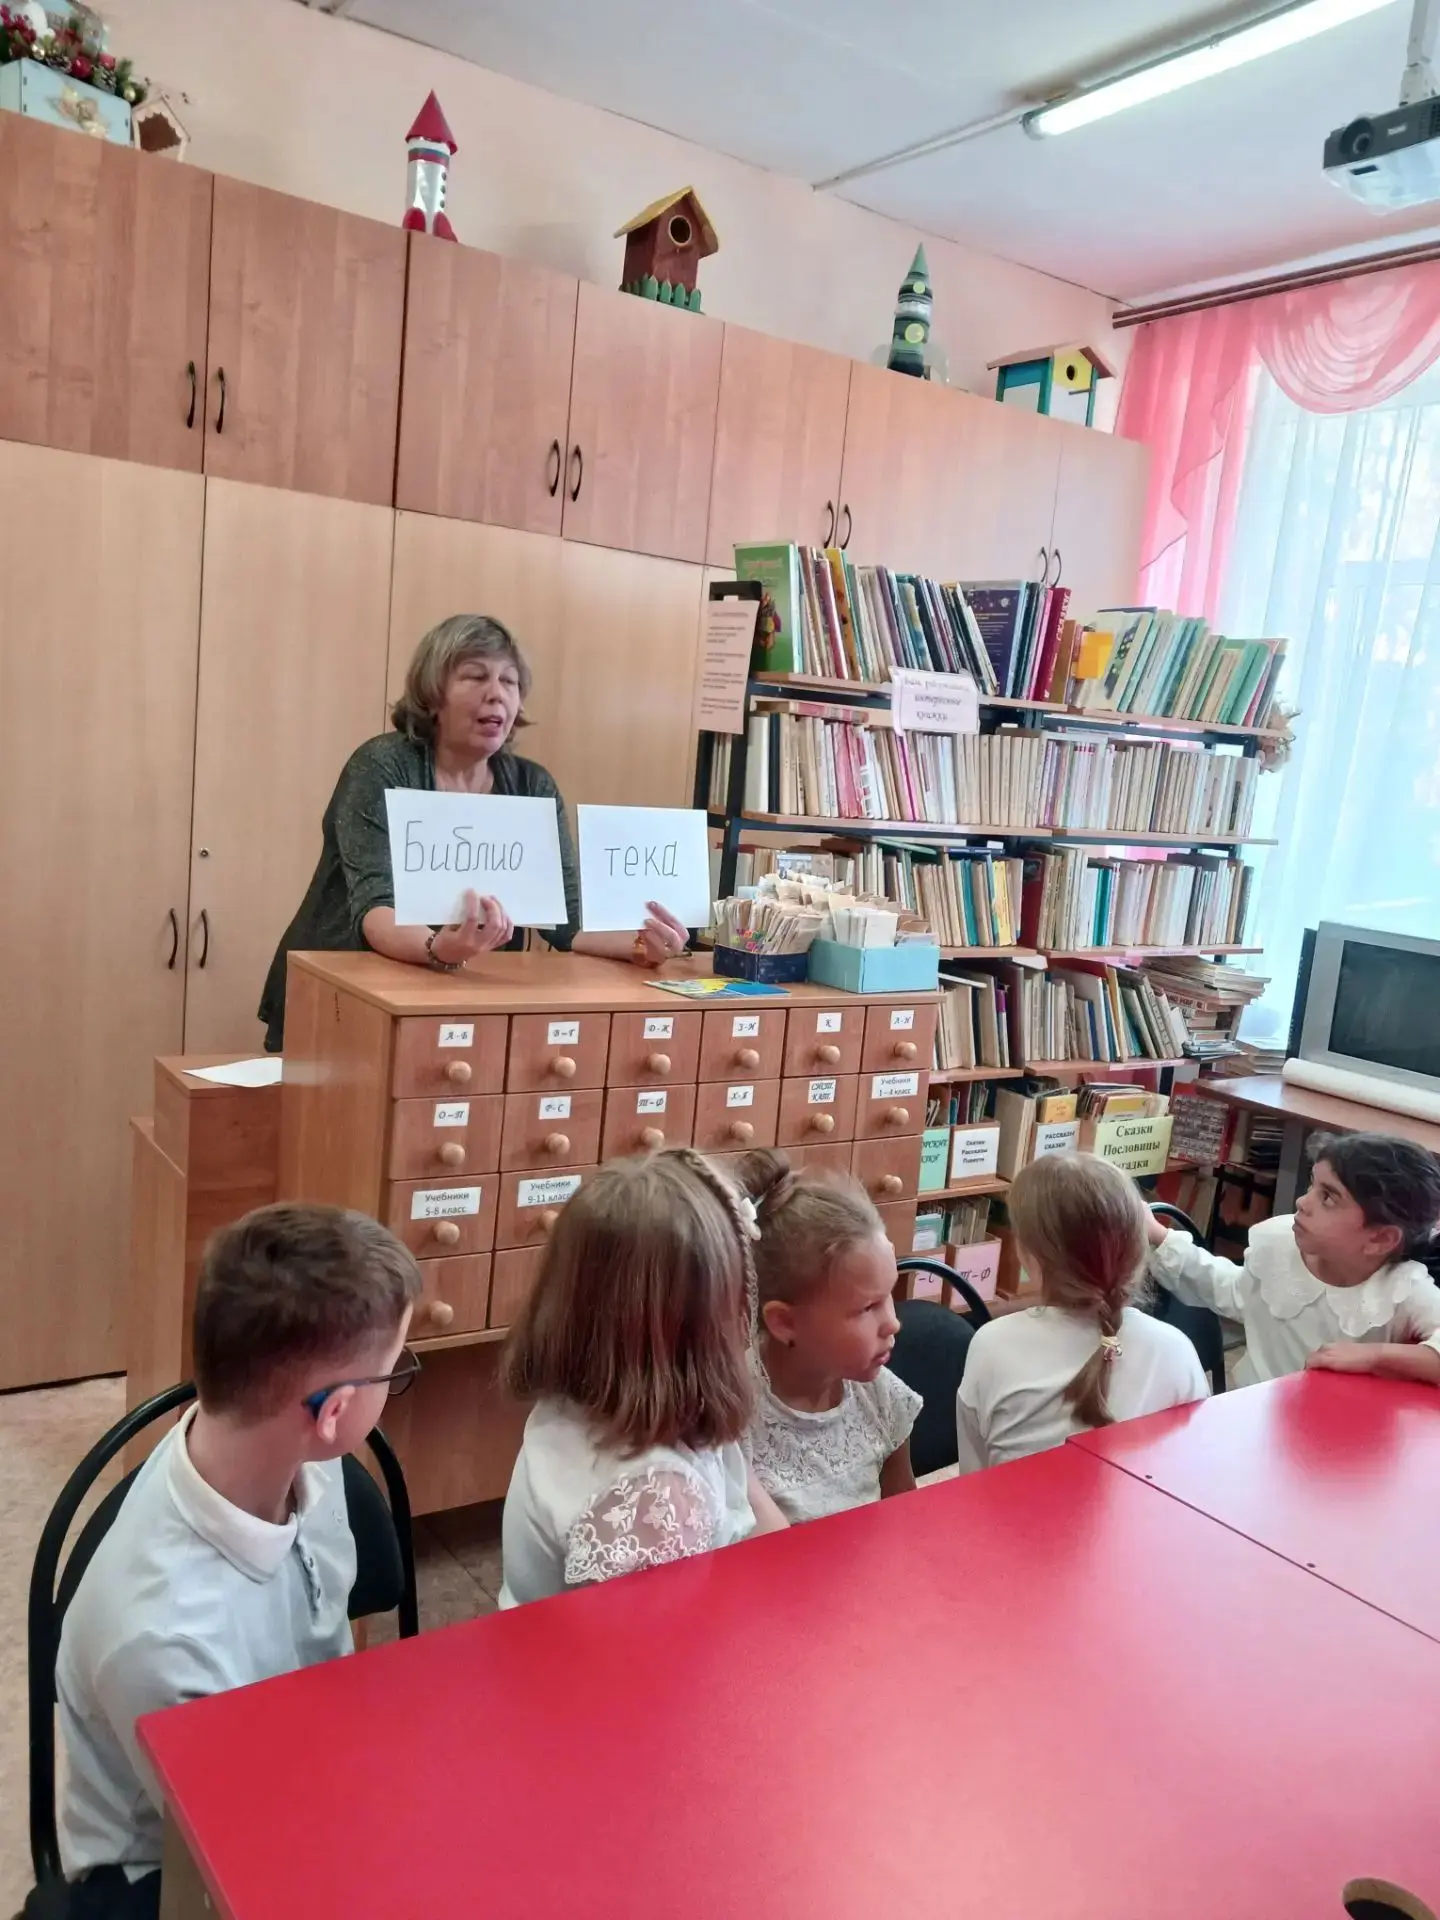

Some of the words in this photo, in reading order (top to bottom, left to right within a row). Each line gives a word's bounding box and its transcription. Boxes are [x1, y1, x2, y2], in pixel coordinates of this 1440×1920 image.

[403, 819, 525, 873] Библио
[604, 840, 679, 877] тека
[880, 1076, 911, 1086] Учебники
[894, 1088, 912, 1096] класс
[1045, 1130, 1075, 1140] РАССКАЗЫ
[1116, 1124, 1153, 1138] Сказки
[1103, 1141, 1161, 1156] Пословицы
[530, 1180, 571, 1190] Учебники
[424, 1192, 470, 1202] Учебники
[527, 1194, 547, 1204] 9-11
[441, 1206, 466, 1215] класс
